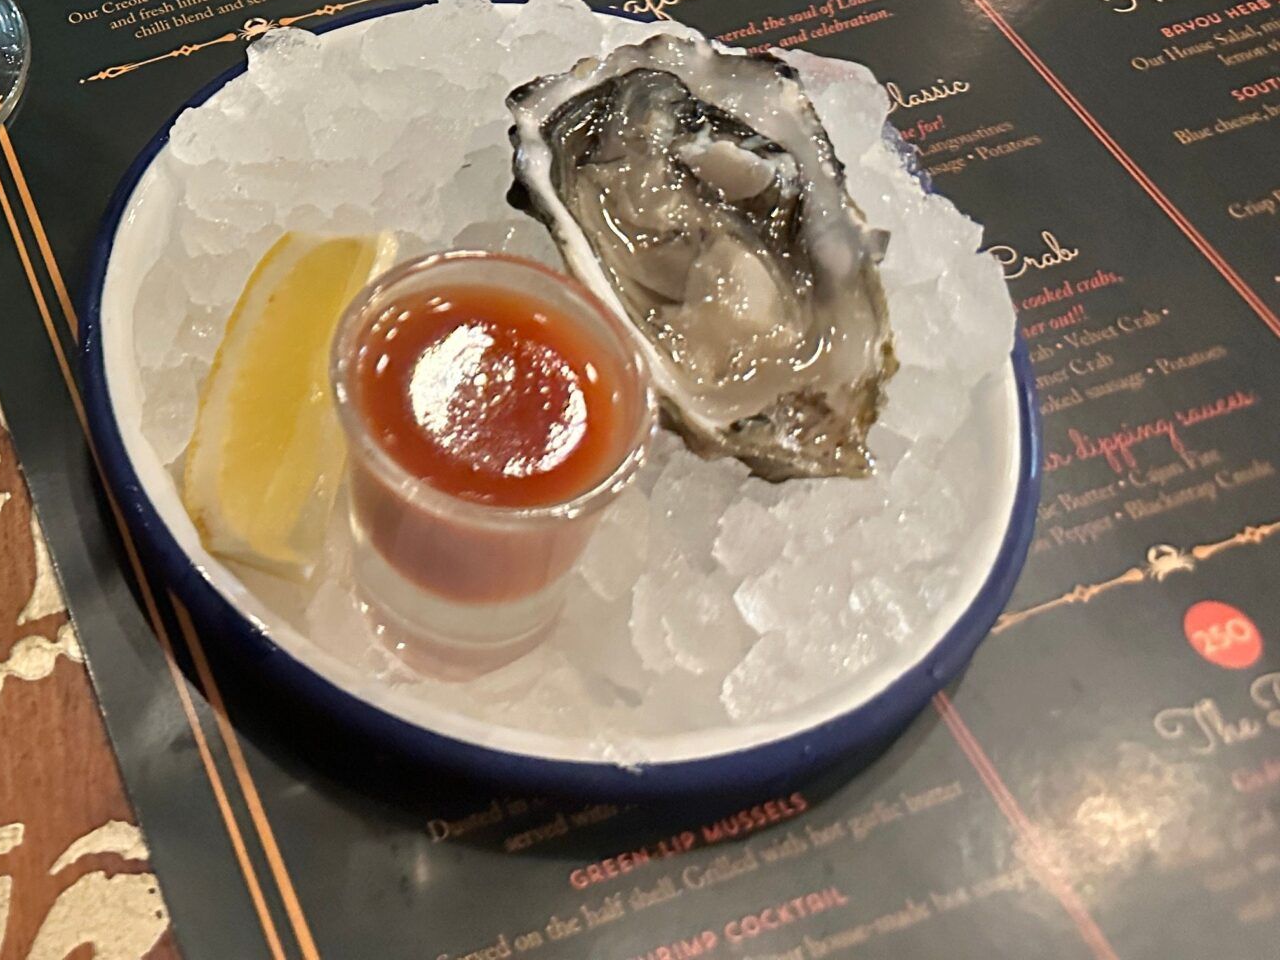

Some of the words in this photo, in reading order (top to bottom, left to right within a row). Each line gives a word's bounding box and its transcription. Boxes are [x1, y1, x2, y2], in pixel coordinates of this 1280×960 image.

[67, 9, 98, 24] Our
[109, 11, 136, 29] and
[138, 1, 174, 20] fresh
[134, 19, 171, 38] chilli
[171, 5, 214, 27] blend
[761, 16, 786, 30] the
[787, 4, 818, 24] soul
[818, 0, 835, 17] of
[1160, 12, 1222, 37] BAYOU
[779, 33, 808, 49] and
[1130, 54, 1165, 70] Our
[1162, 40, 1215, 61] House
[887, 78, 970, 114] lassic
[975, 135, 1042, 160] Potatoes
[986, 230, 1078, 279] Crab
[1022, 282, 1074, 309] cooked
[702, 794, 806, 840] MUSSELS
[724, 890, 848, 941] COCKTAIL
